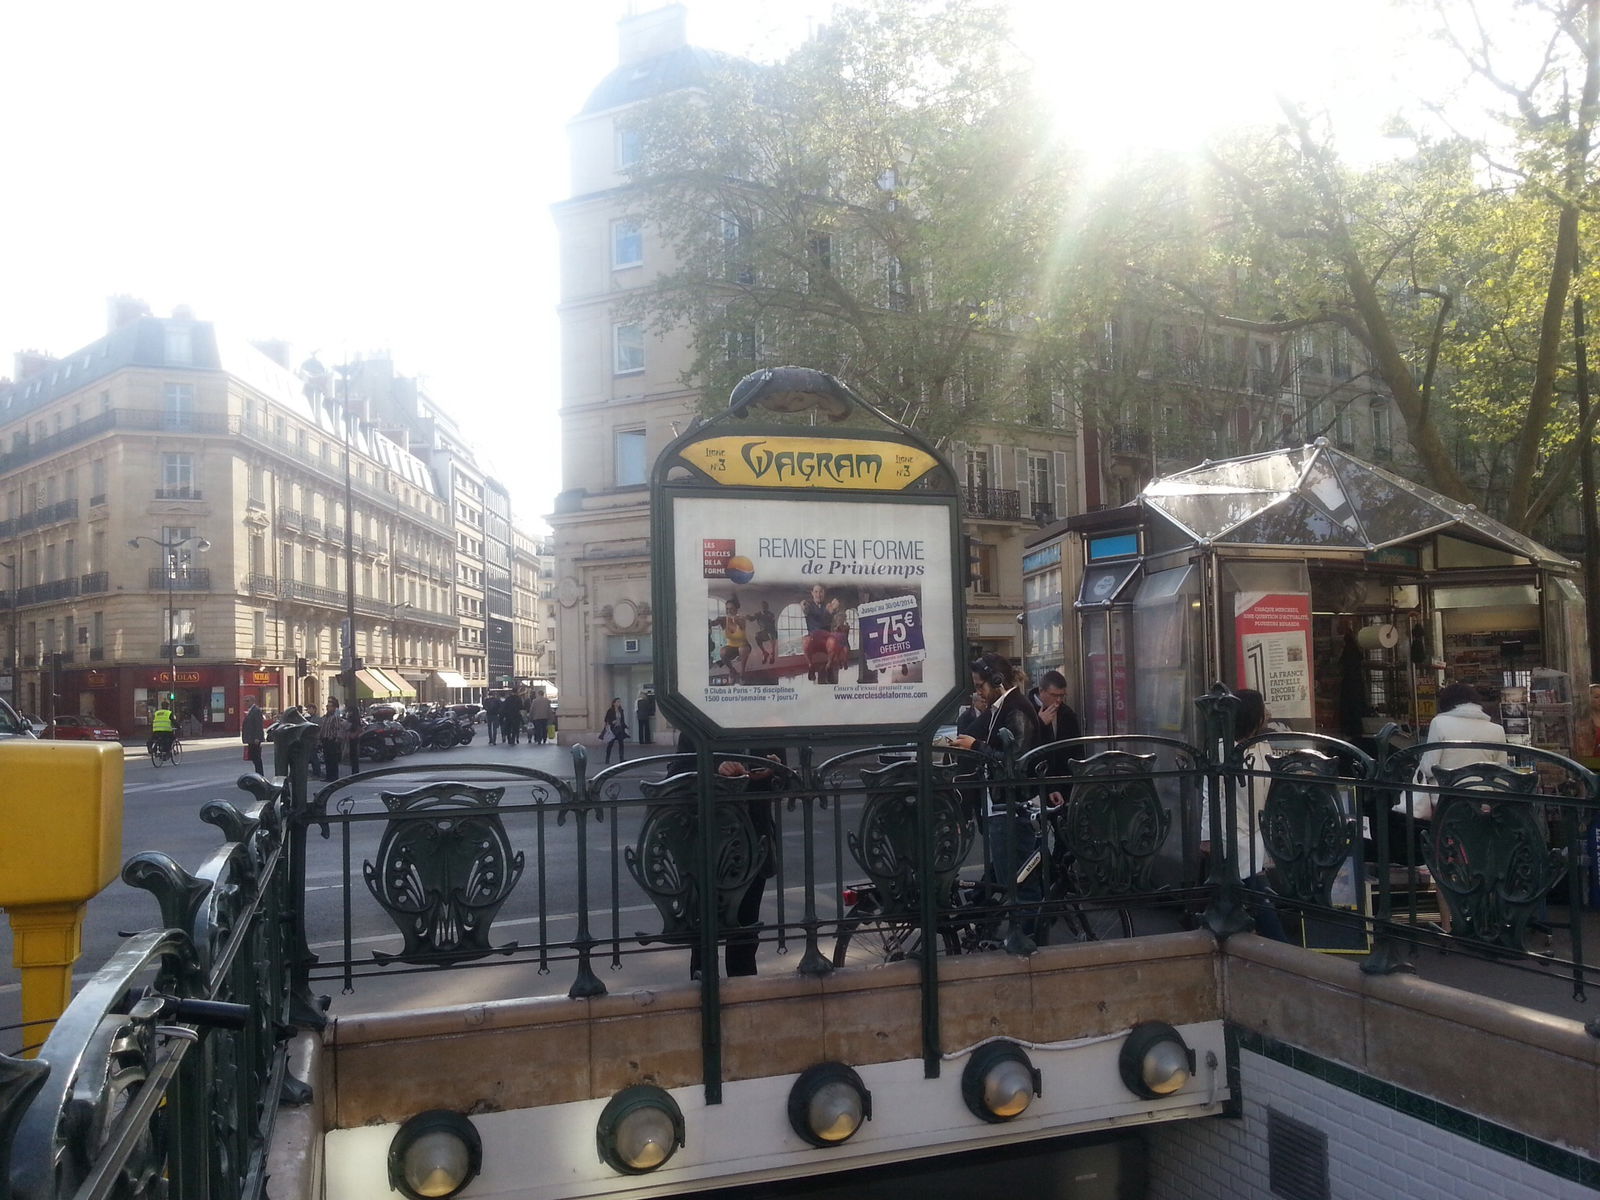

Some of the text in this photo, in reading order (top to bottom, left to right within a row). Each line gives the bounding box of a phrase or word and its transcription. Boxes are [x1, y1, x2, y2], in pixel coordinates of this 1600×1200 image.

[741, 441, 882, 483] WAGRAM
[759, 538, 925, 560] REMISE EN FORME
[801, 560, 925, 578] de Printemps
[880, 641, 911, 654] OFFERTS
[1269, 670, 1303, 679] LA FRANCE
[704, 687, 709, 695] 9
[762, 686, 795, 695] disciplines
[834, 691, 928, 700] www.cerclesdelaforme.com
[1270, 686, 1296, 694] ENCORE
